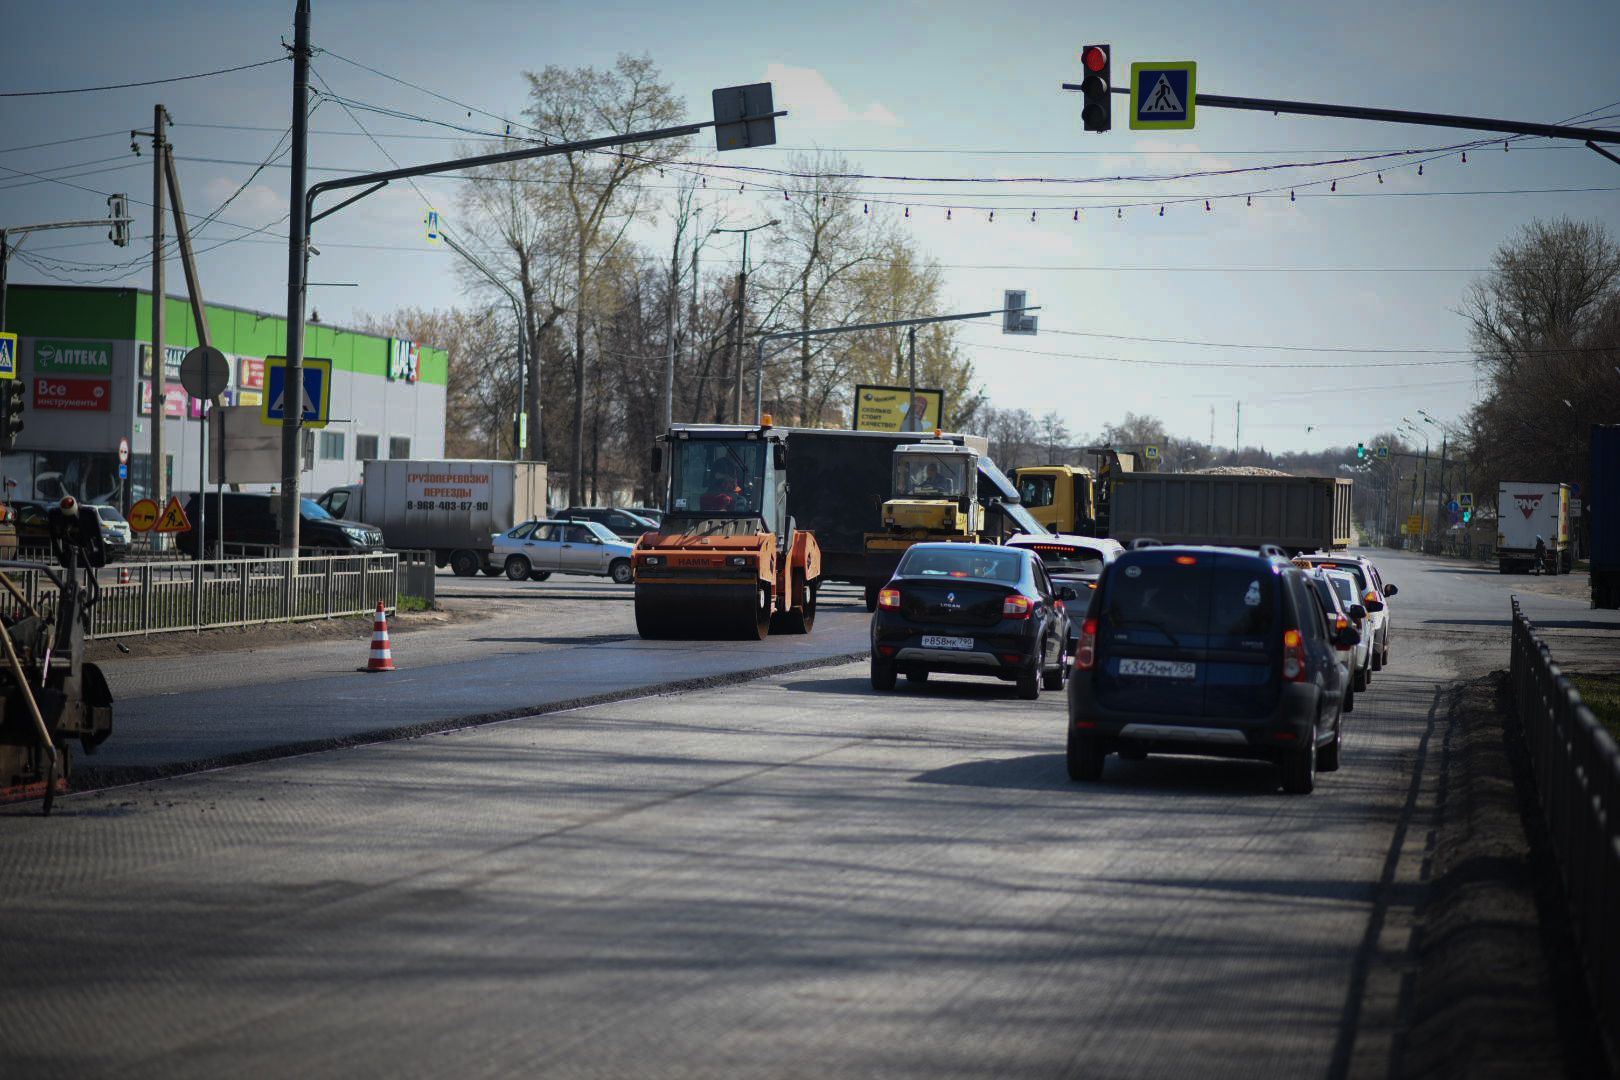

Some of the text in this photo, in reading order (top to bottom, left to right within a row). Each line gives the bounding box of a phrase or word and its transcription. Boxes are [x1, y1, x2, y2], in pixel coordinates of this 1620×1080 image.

[54, 349, 108, 366] АПТЕКА
[38, 380, 67, 396] Все
[38, 398, 98, 408] инструменты
[407, 473, 489, 484] ГРУЗОПЕРЕВОЗКИ
[424, 487, 472, 498] ПЕРЕЕЗДЫ
[678, 558, 710, 566] HAMM
